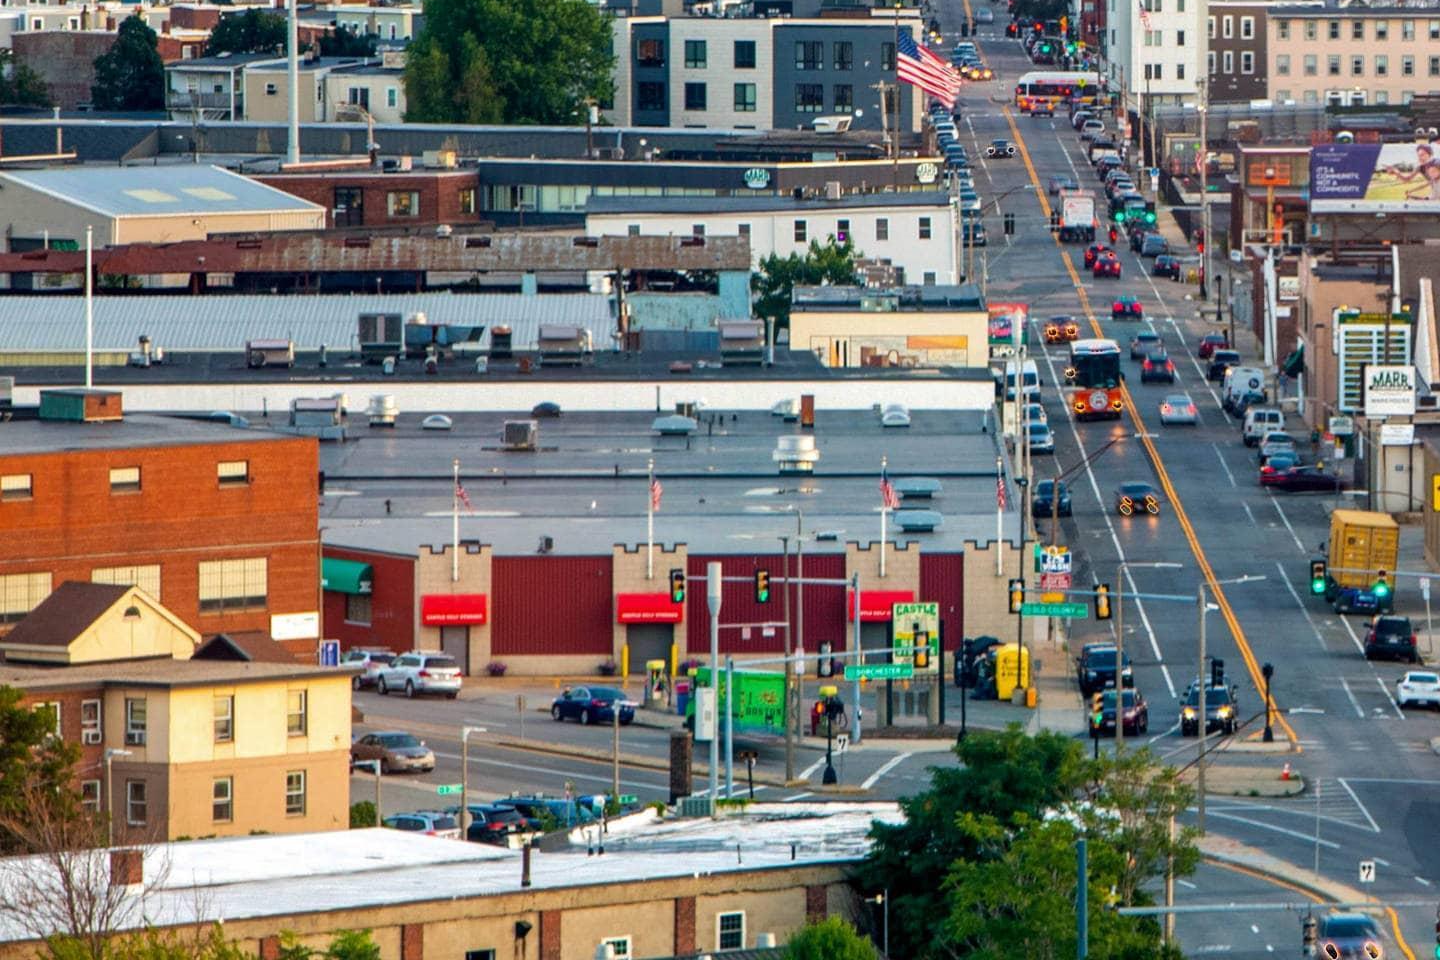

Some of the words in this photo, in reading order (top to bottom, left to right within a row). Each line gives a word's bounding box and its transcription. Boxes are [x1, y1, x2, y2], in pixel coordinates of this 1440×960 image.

[1372, 371, 1409, 387] MARR
[896, 604, 937, 616] CASTLE
[855, 668, 901, 677] DORCHESTER
